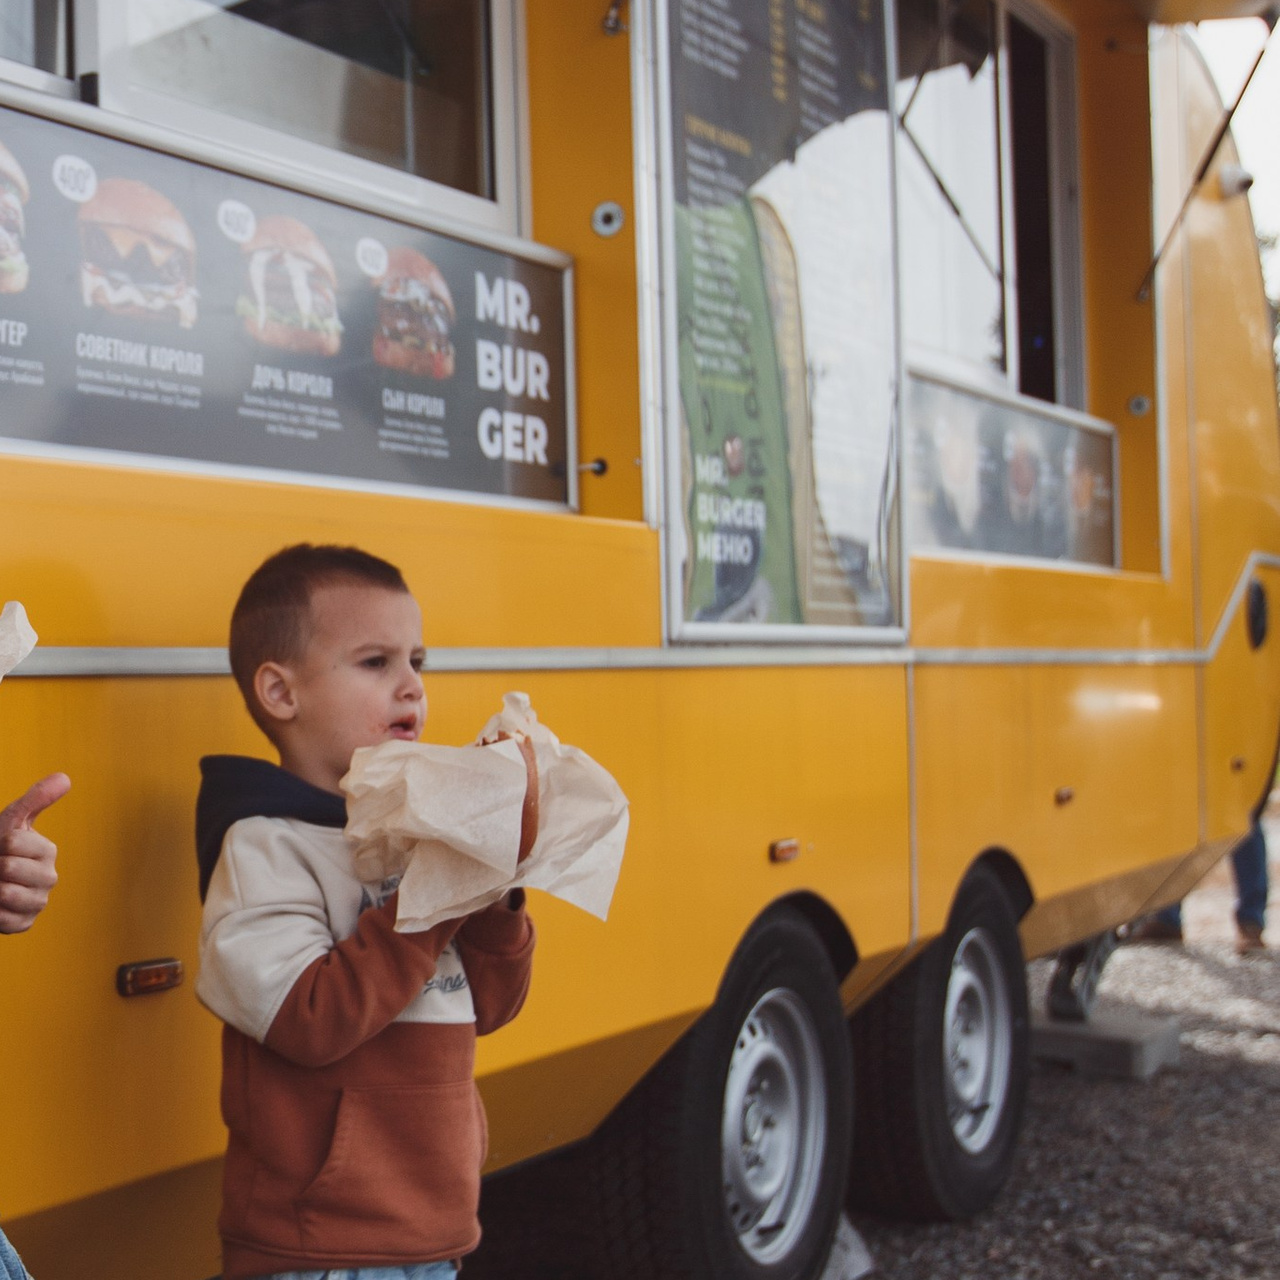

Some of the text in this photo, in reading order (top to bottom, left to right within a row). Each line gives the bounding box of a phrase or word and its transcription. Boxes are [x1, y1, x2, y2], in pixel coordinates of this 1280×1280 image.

[474, 270, 541, 335] MR.
[475, 339, 551, 402] BUR
[476, 407, 549, 466] GER
[697, 492, 767, 531] BURGER
